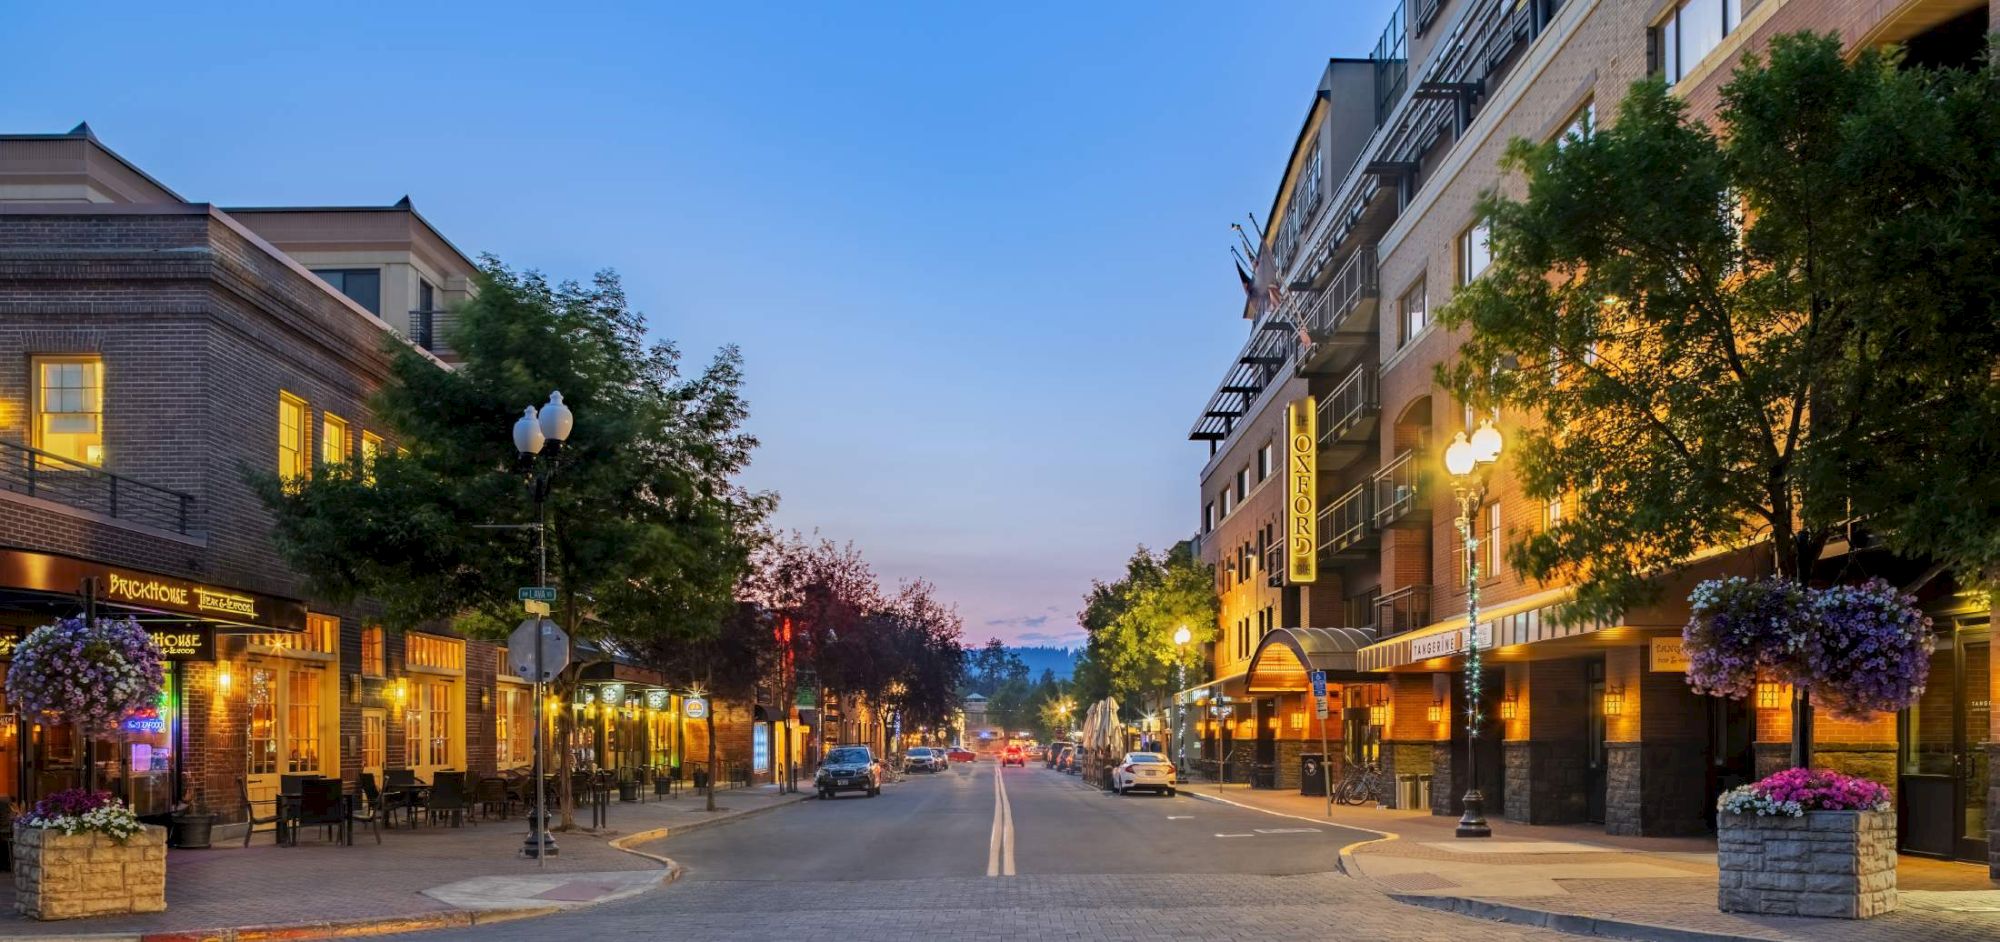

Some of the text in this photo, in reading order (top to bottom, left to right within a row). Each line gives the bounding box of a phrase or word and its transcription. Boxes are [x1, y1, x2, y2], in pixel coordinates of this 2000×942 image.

[1294, 434, 1312, 556] OXFORD
[109, 573, 189, 604] BRICKHOUSE
[1414, 636, 1454, 655] TANGERINE
